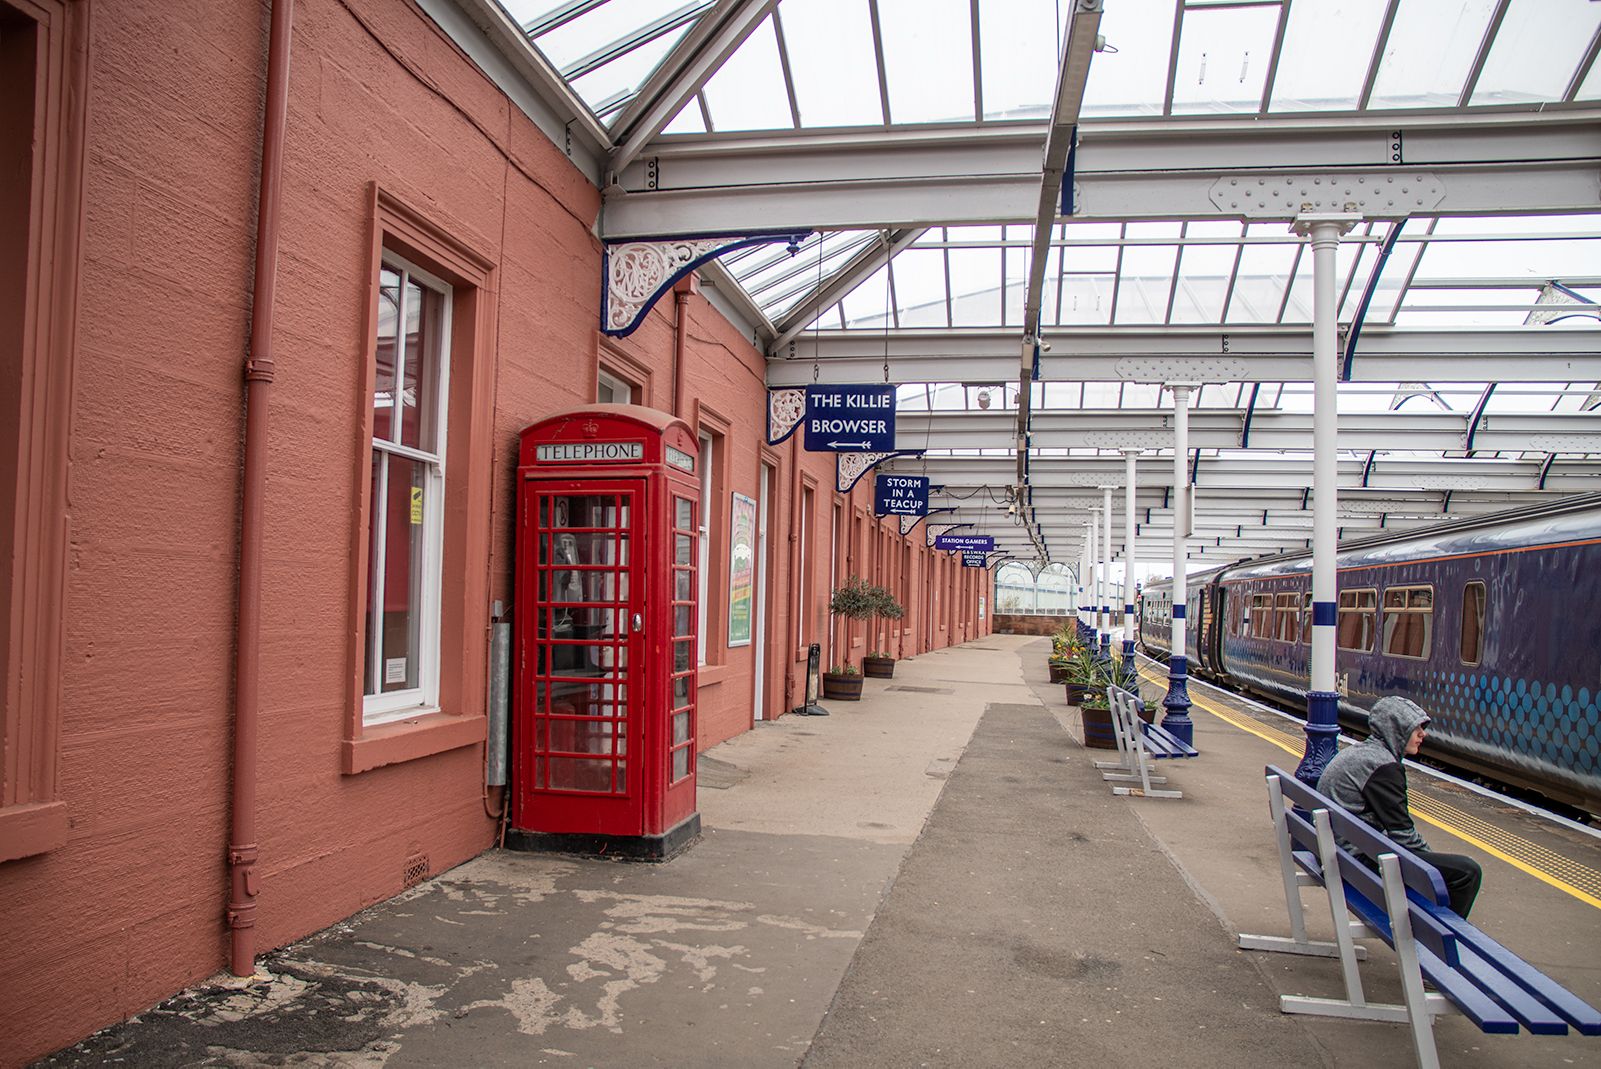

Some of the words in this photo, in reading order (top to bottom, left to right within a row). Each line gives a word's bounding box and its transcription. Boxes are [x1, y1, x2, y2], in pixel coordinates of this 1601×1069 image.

[811, 394, 842, 408] THE
[846, 394, 890, 408] KILLIE
[811, 419, 887, 434] BROWSER
[541, 444, 640, 460] TELEPHONE
[886, 478, 921, 488] STORM
[892, 488, 904, 498] IN
[906, 489, 915, 498] A
[883, 498, 924, 509] TEACUP
